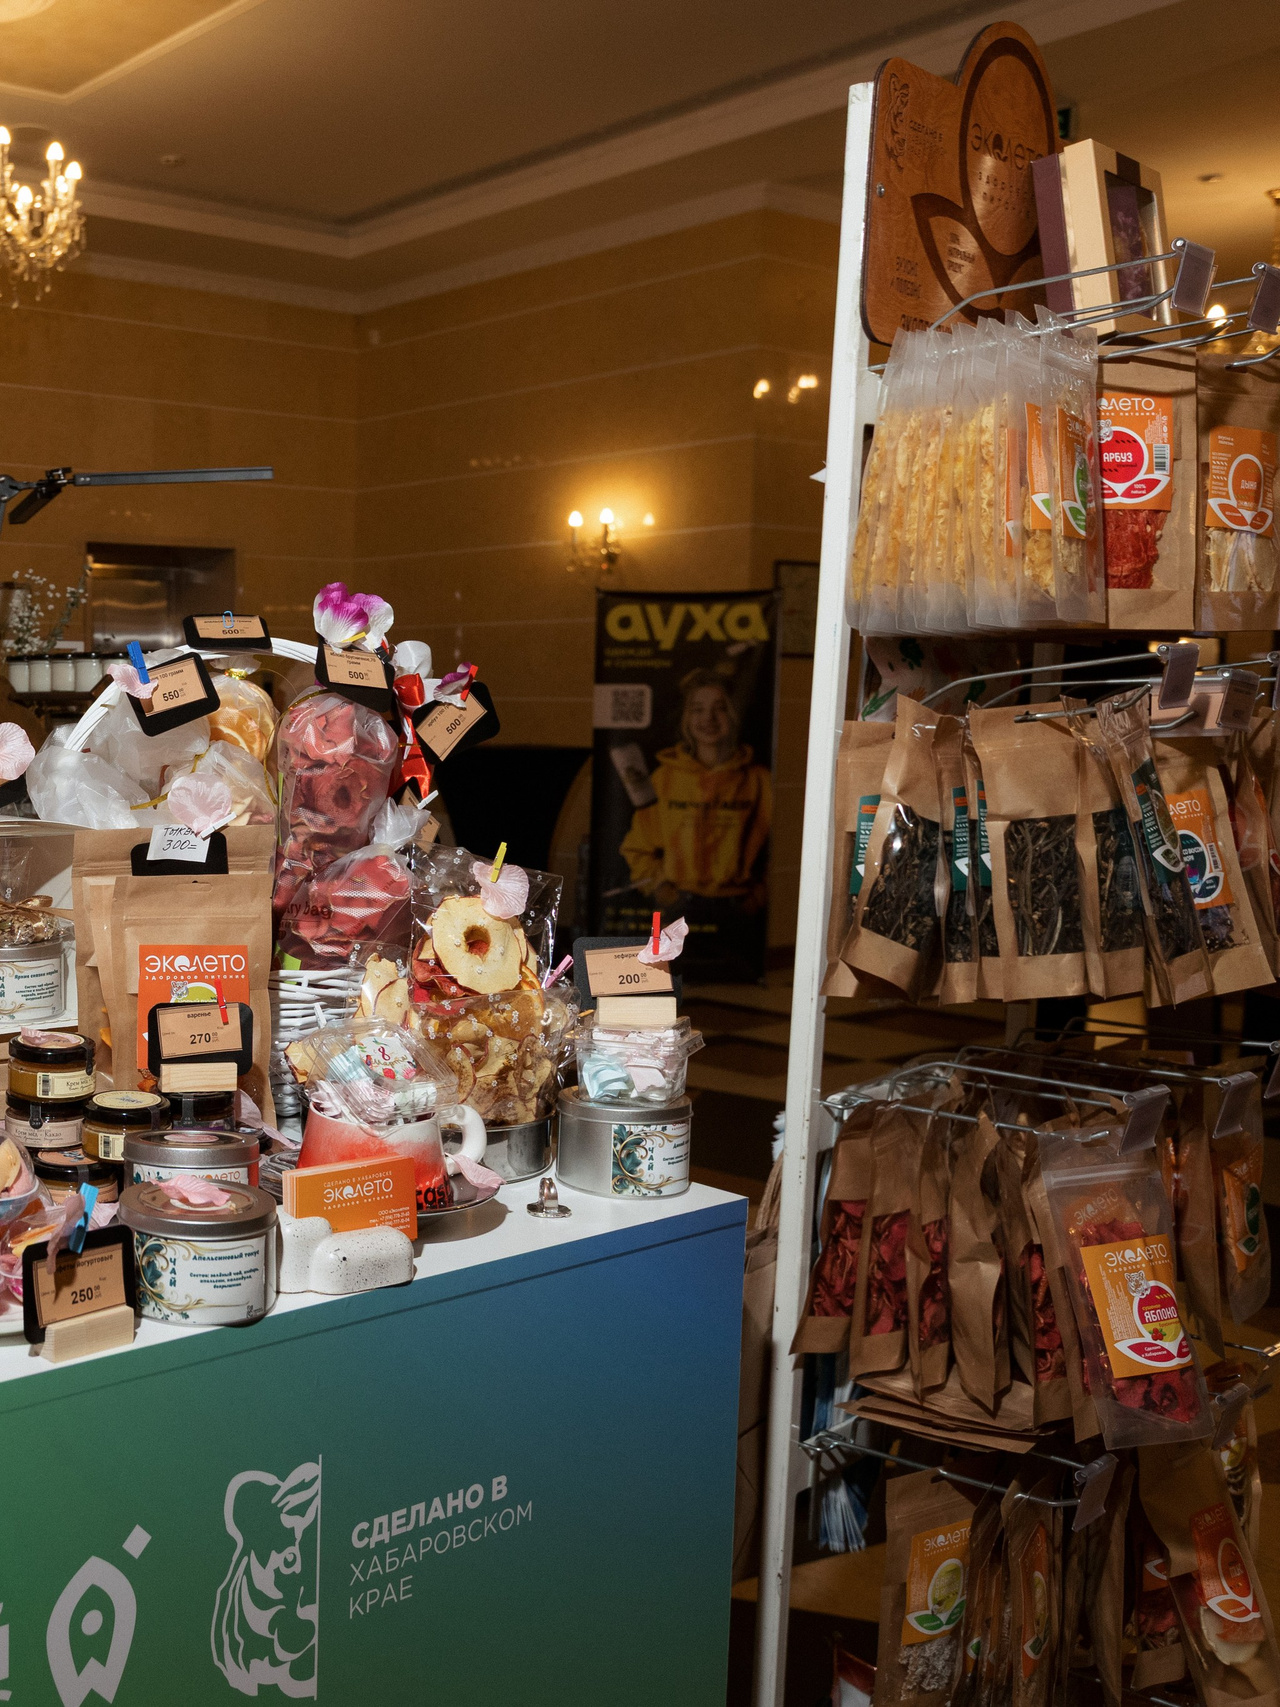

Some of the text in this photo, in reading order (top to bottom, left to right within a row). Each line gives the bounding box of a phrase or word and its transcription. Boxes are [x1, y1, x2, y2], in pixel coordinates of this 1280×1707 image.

[1097, 398, 1155, 411] ОЛЕТО
[1103, 452, 1133, 462] АРБУЗ
[348, 670, 365, 680] 500
[162, 689, 180, 702] 550
[445, 718, 462, 735] 500
[145, 954, 246, 973] ЭКОЛЕТО
[618, 973, 640, 985] 200
[187, 1011, 212, 1019] варенье
[190, 1033, 211, 1045] 270
[378, 1045, 391, 1061] 8
[324, 1178, 351, 1188] СДЕЛАНО
[358, 1170, 393, 1181] ХАБАРОВСКЕ
[323, 1178, 393, 1204] ЭКОЛЕТО
[192, 1252, 244, 1261] Апельсиновый
[1104, 1243, 1168, 1267] ЭКОЛЕТО
[169, 1257, 177, 1287] ЧАЙ
[71, 1286, 94, 1305] 250
[1144, 1306, 1178, 1323] ЯБЛОКО
[351, 1475, 510, 1550] СДЕЛАНО В
[349, 1501, 534, 1586] ХАБАРОВСКОМ
[349, 1576, 414, 1620] КРАЕ
